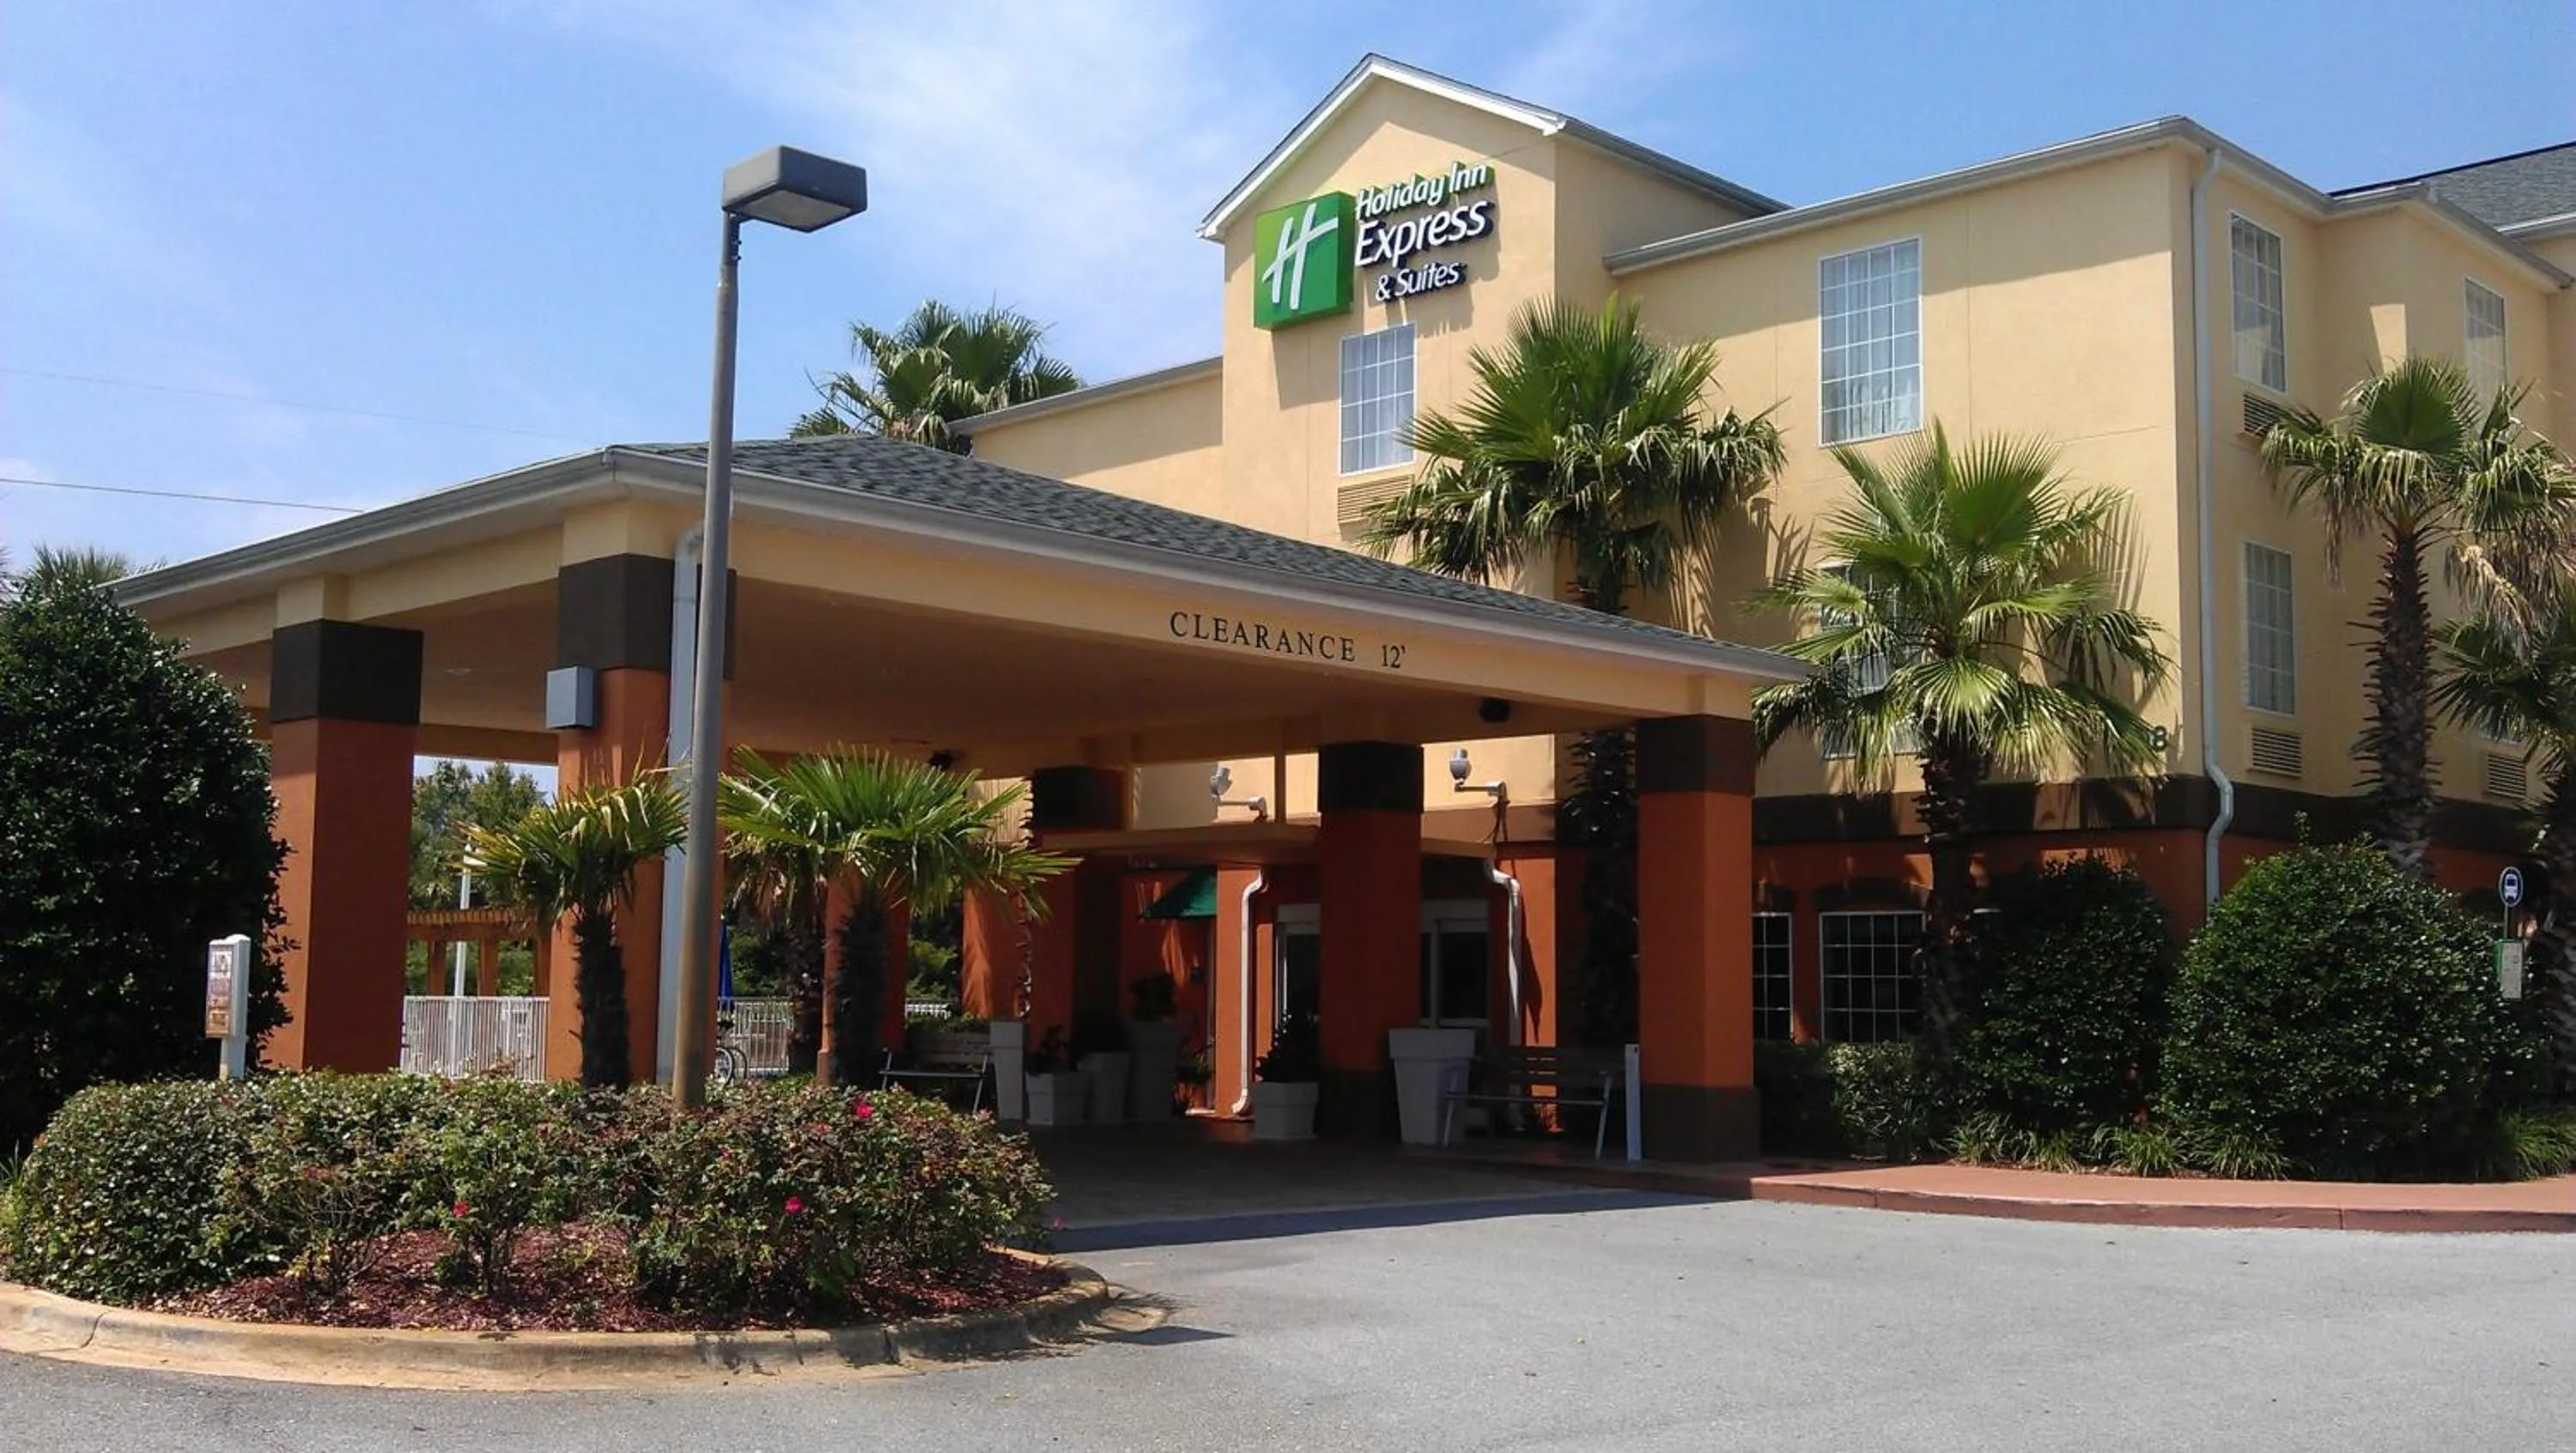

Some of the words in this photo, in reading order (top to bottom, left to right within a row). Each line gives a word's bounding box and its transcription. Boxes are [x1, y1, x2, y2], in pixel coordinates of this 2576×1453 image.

[1355, 174, 1446, 221] Holiday
[1449, 161, 1488, 194] Inn
[1261, 202, 1339, 310] H
[1354, 200, 1490, 268] Express
[1375, 274, 1391, 301] &
[1394, 262, 1460, 297] Suites
[1170, 611, 1356, 662] CLEARANCE
[1381, 644, 1406, 669] 12'
